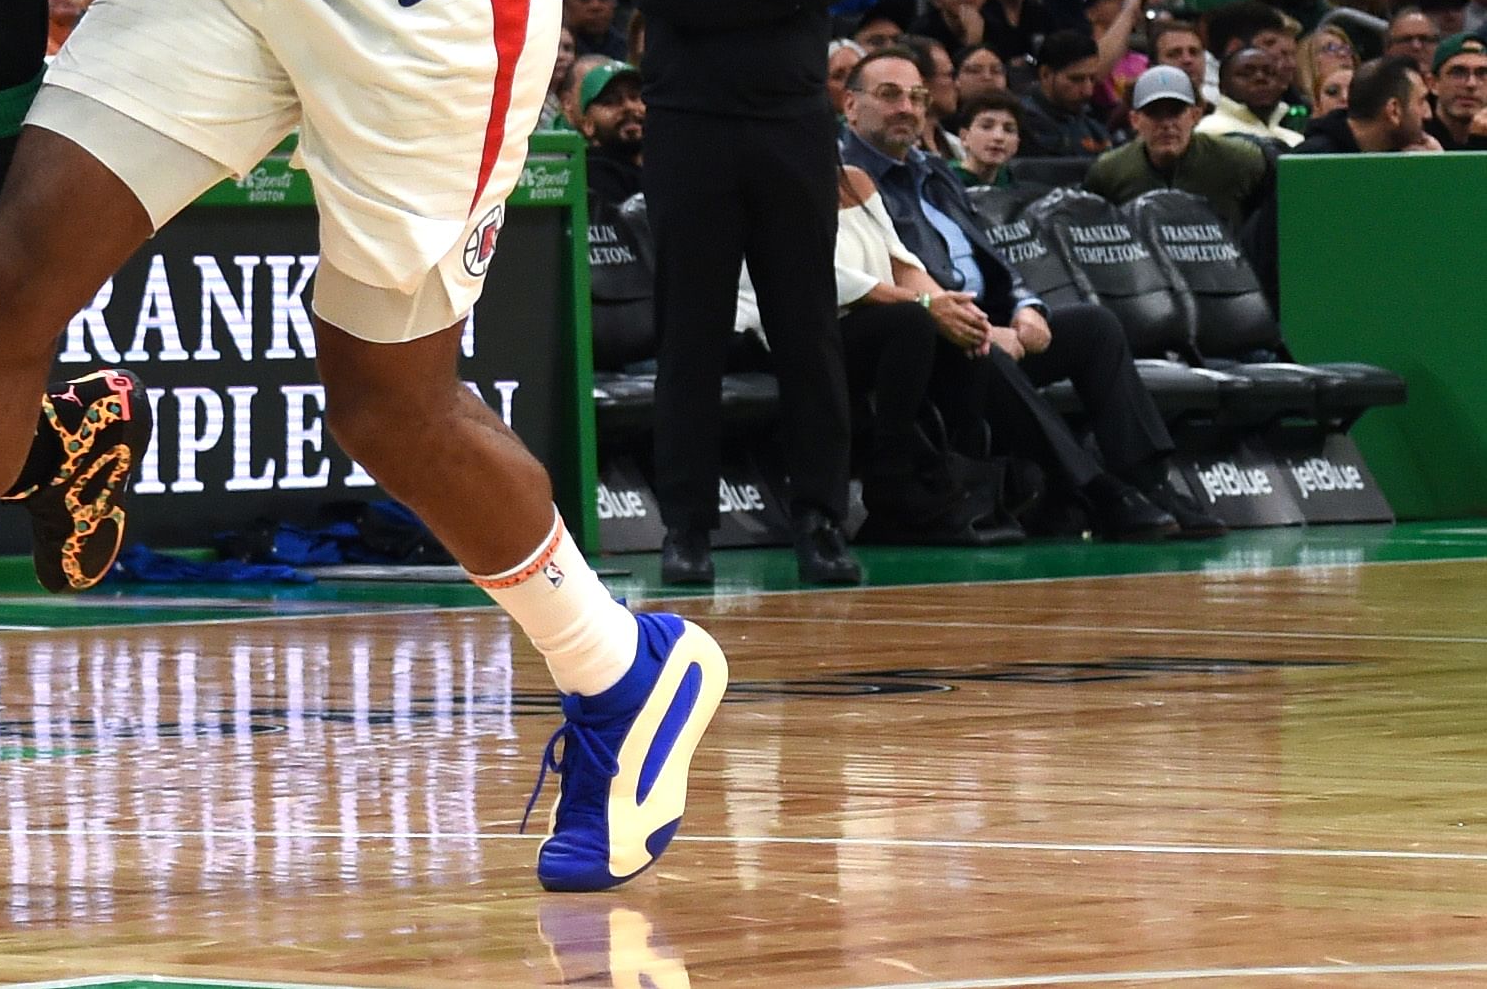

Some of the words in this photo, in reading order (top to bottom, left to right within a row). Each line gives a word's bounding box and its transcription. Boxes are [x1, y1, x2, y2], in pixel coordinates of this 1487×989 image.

[1195, 461, 1273, 503] jetBlue
[1287, 458, 1364, 499] jetBlue
[597, 483, 646, 519] Blue
